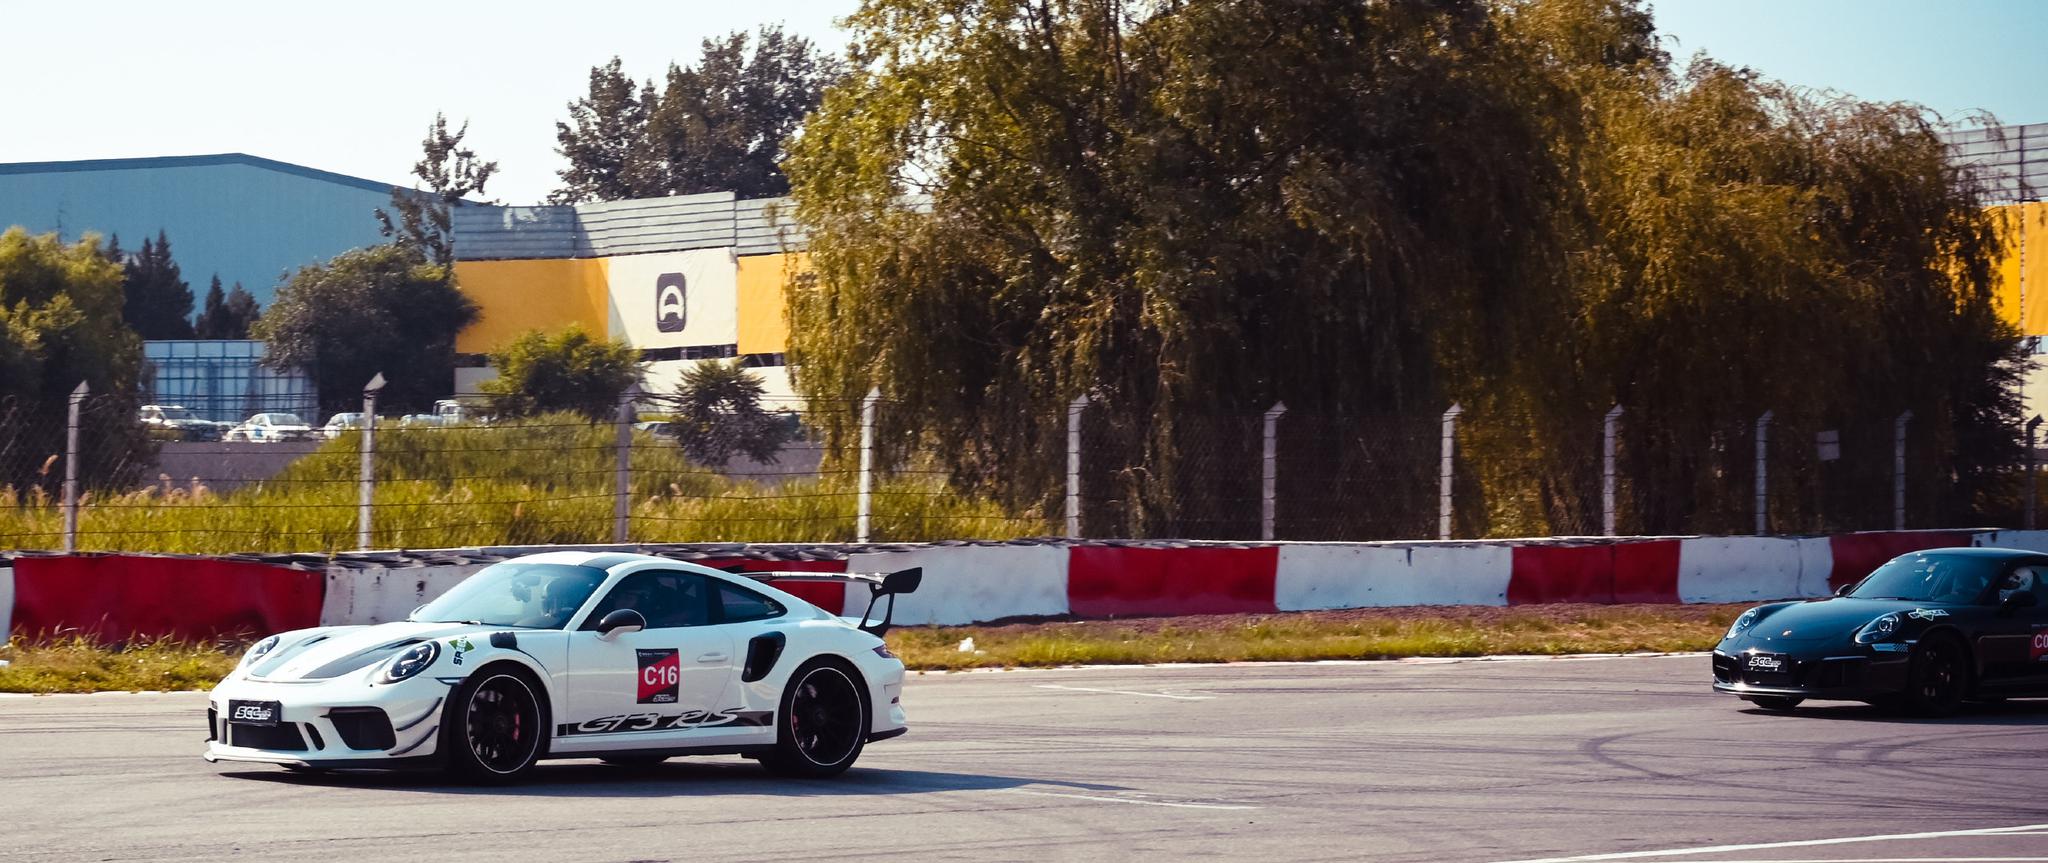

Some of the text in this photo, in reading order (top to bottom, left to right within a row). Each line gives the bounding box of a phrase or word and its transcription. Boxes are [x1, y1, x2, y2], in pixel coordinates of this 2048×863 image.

[644, 665, 678, 685] C16
[577, 706, 746, 732] GT3 RS
